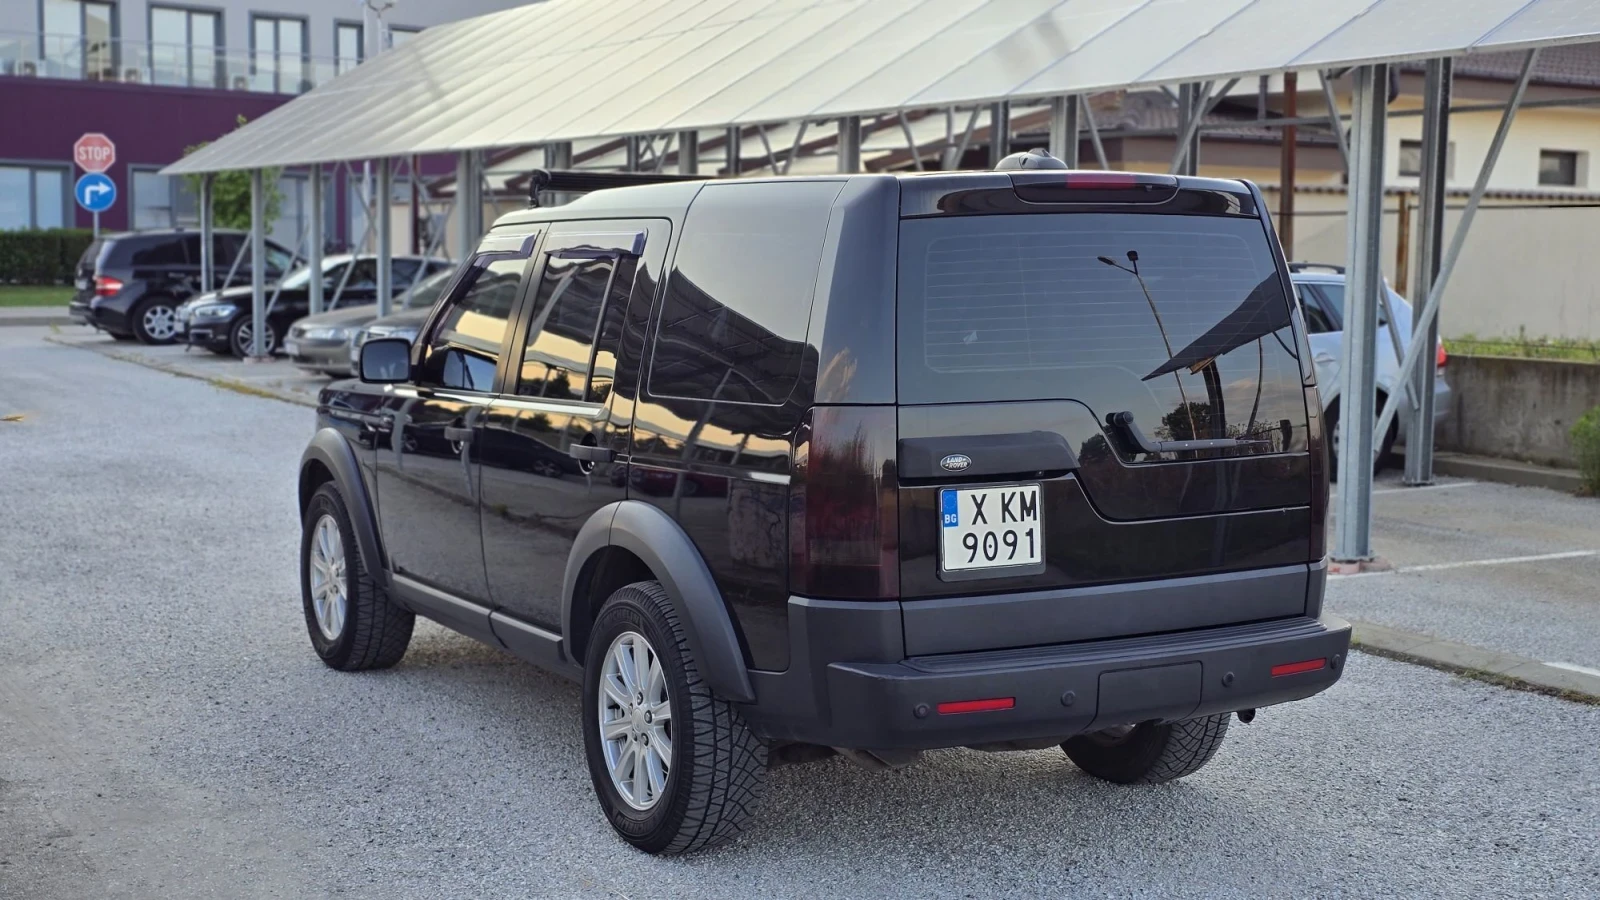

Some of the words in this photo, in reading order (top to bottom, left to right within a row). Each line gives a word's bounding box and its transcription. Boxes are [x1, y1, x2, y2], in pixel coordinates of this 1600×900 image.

[79, 145, 111, 160] STOP
[944, 513, 957, 524] BG
[970, 493, 988, 525] X
[1001, 490, 1037, 523] KM
[962, 528, 1035, 563] 9091
